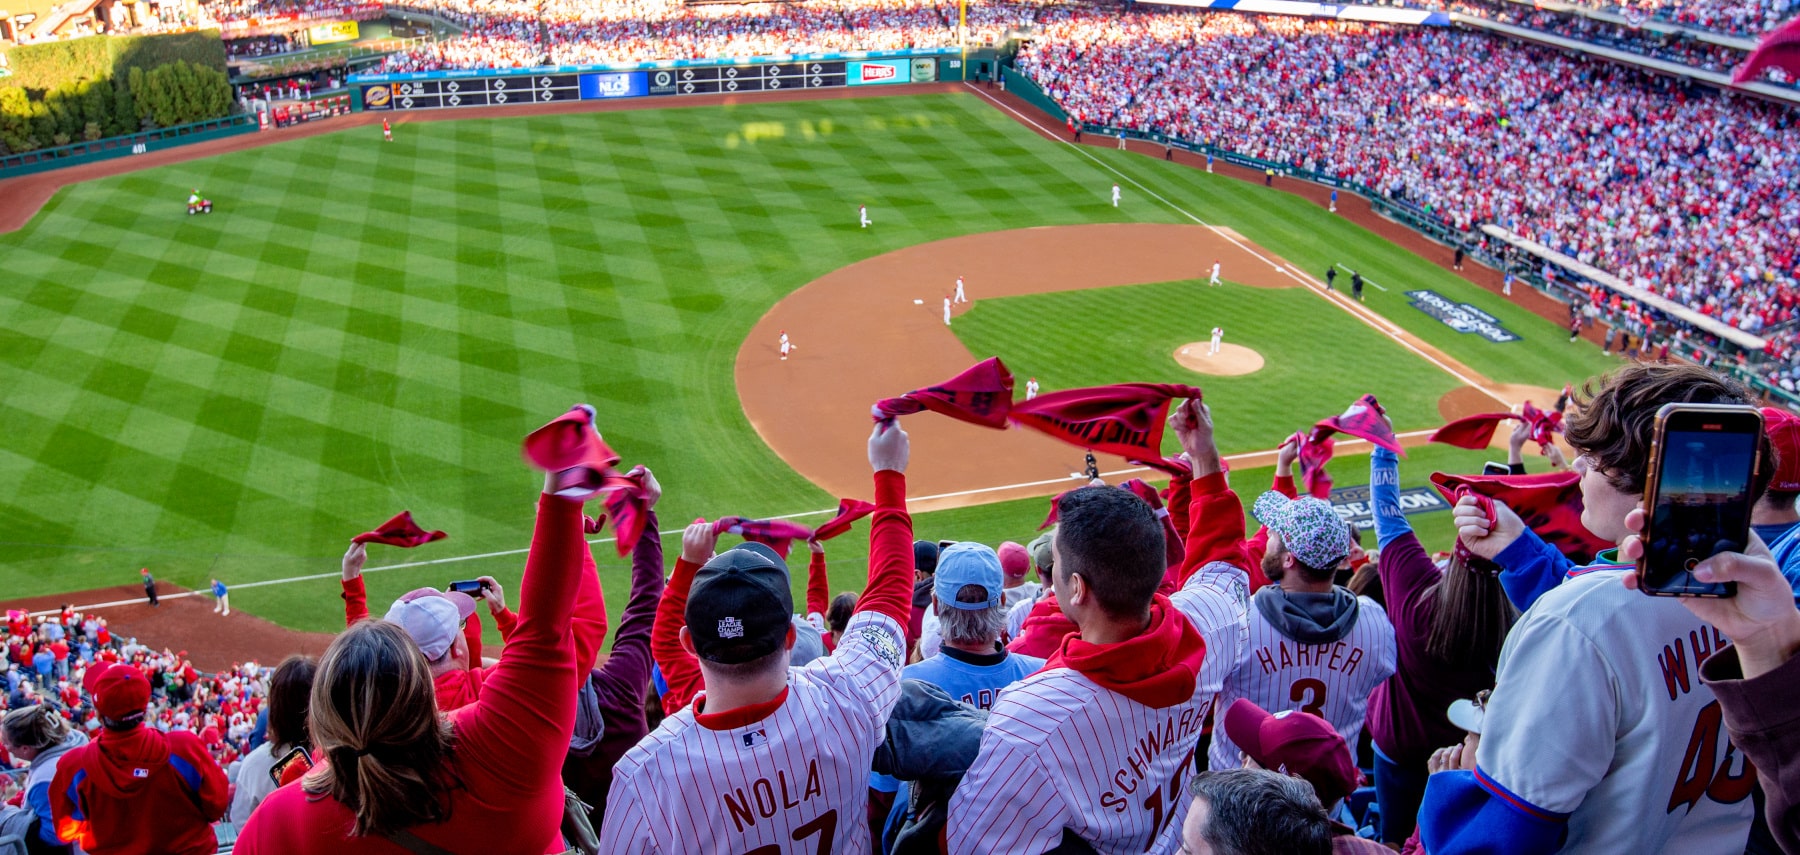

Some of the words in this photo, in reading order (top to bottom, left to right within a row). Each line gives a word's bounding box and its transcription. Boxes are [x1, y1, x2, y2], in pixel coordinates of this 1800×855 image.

[133, 143, 146, 154] 401
[1256, 641, 1364, 676] HARPER
[1289, 677, 1327, 720] 3
[723, 758, 822, 833] NOLA
